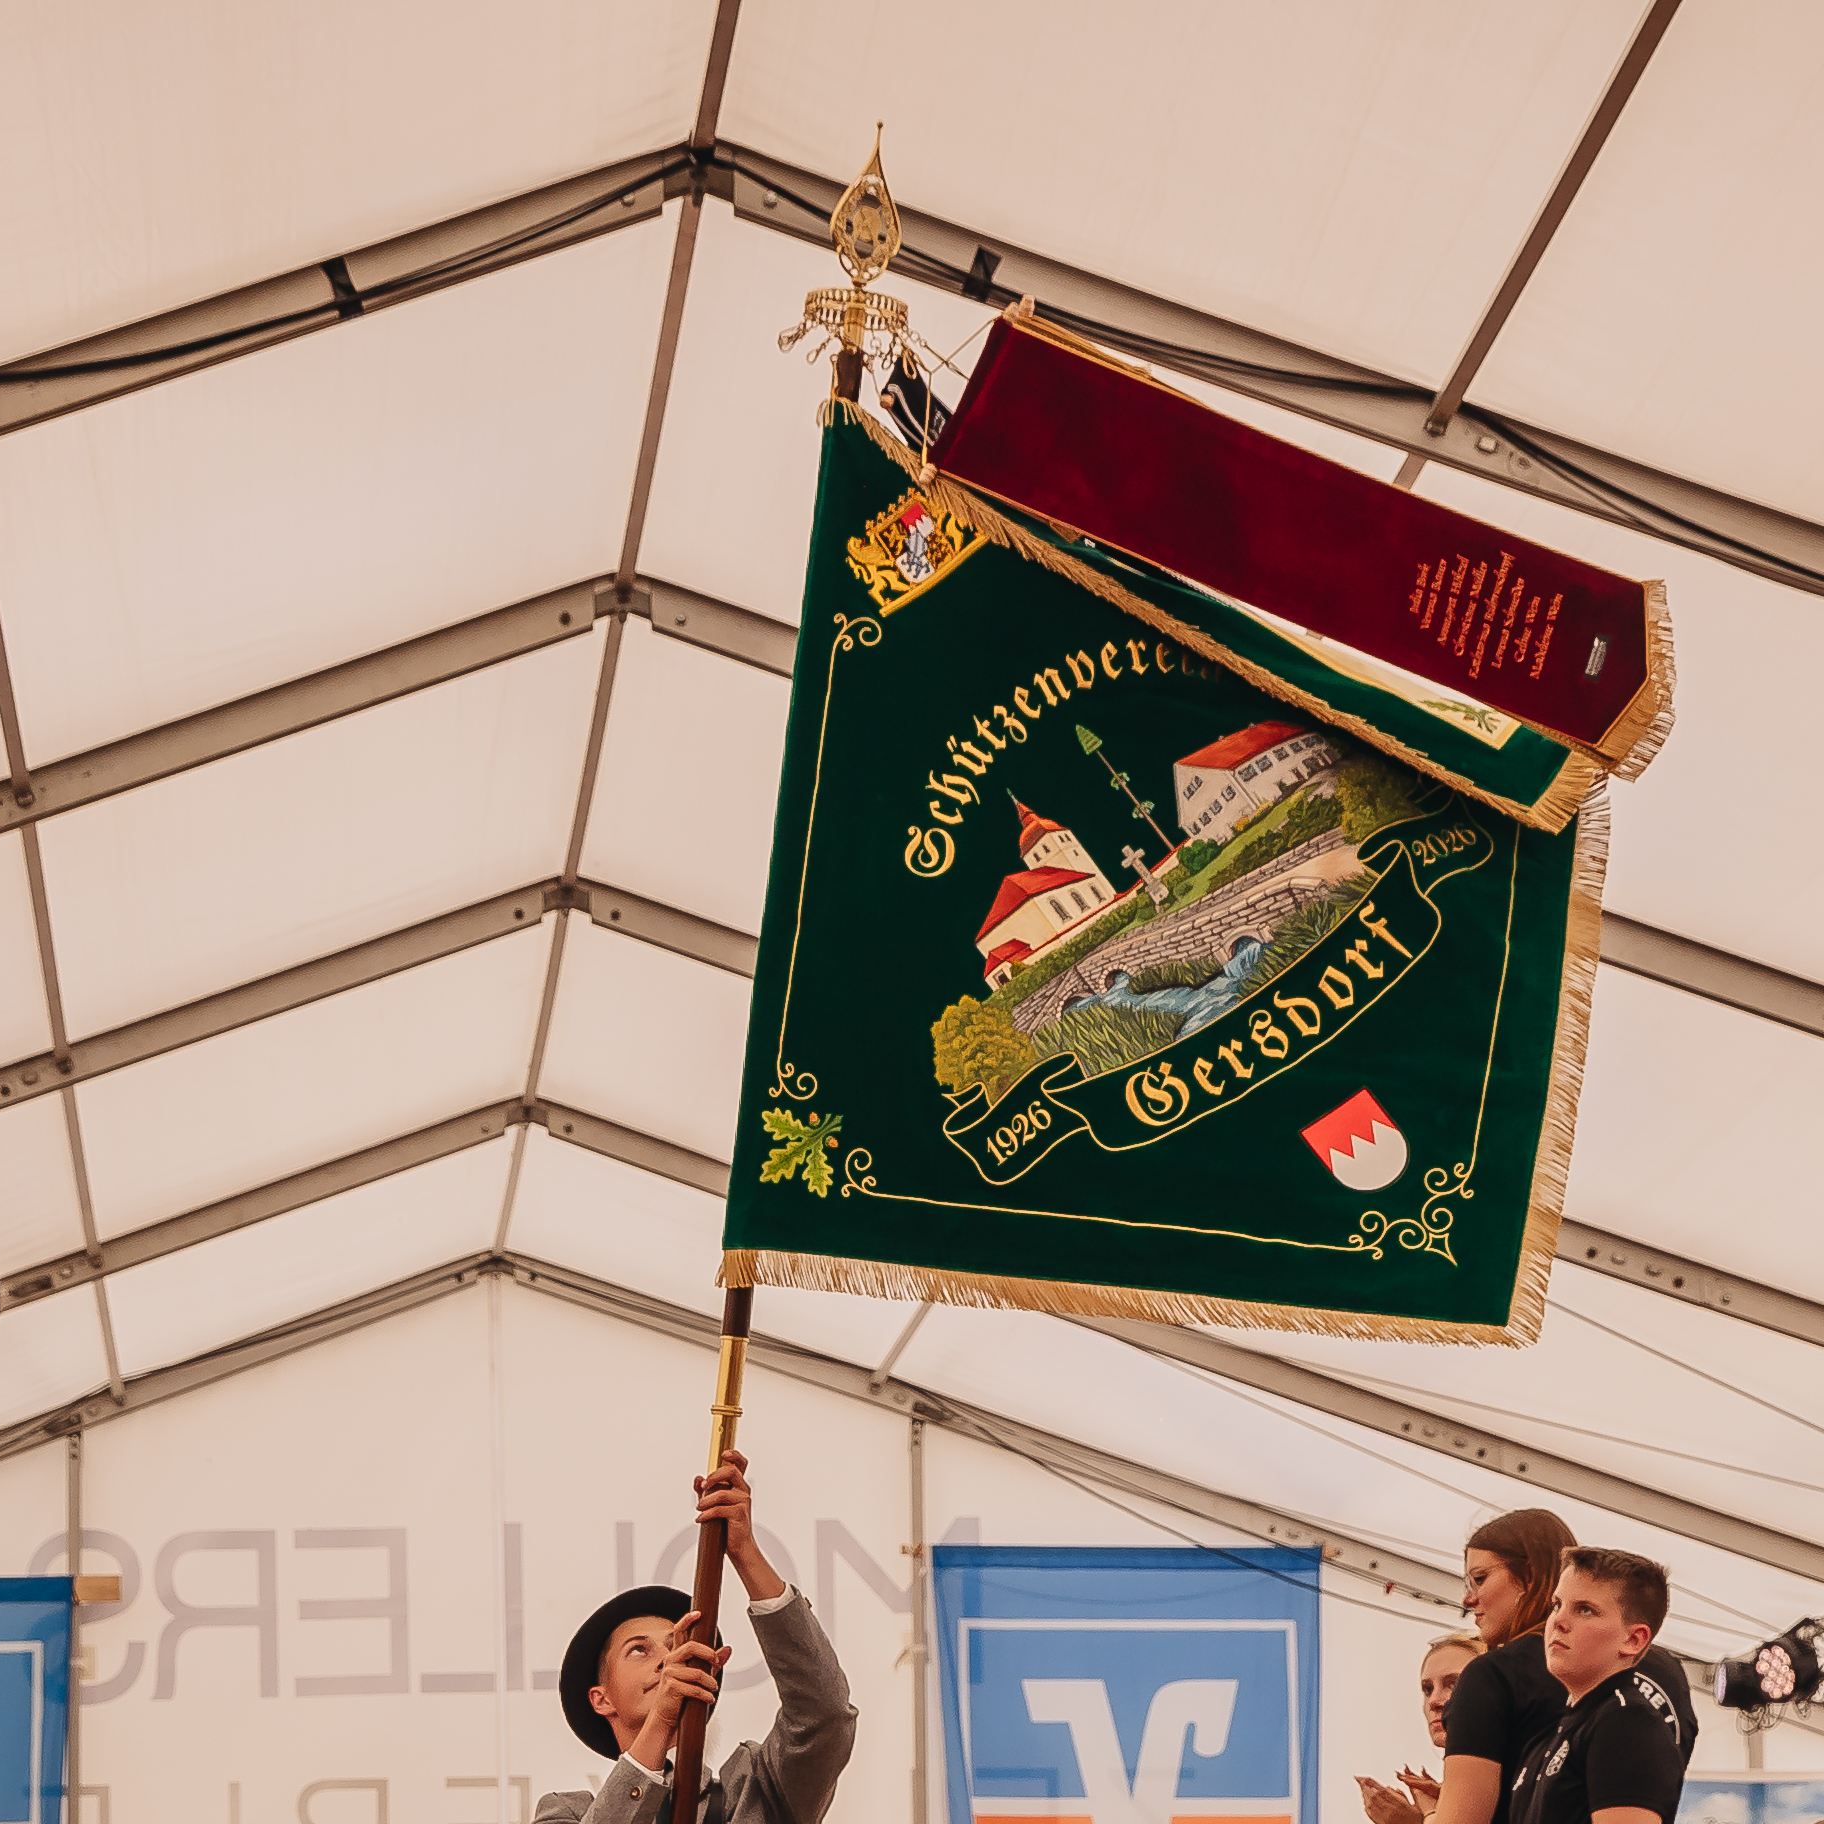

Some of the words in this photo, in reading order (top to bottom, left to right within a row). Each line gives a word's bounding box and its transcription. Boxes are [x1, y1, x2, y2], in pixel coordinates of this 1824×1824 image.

[1413, 821, 1477, 870] 2026
[1123, 908, 1415, 1129] Gersdorf
[984, 1101, 1052, 1168] 1926
